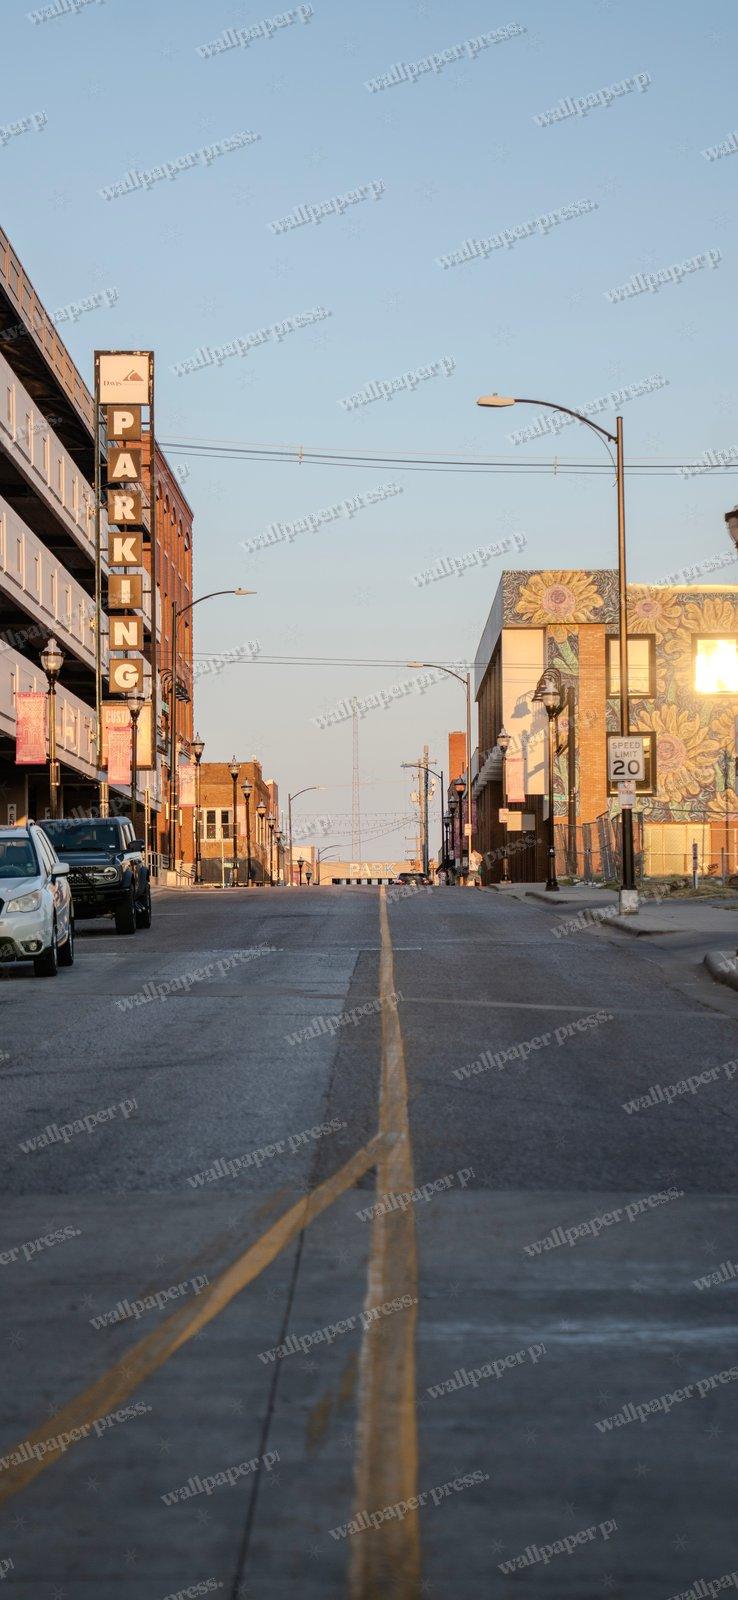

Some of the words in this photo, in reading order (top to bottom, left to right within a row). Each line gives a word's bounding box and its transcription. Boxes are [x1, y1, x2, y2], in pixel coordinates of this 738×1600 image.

[113, 411, 139, 688] PARKING
[612, 741, 641, 750] SPEED
[613, 760, 640, 775] 20
[349, 863, 398, 877] PARK
